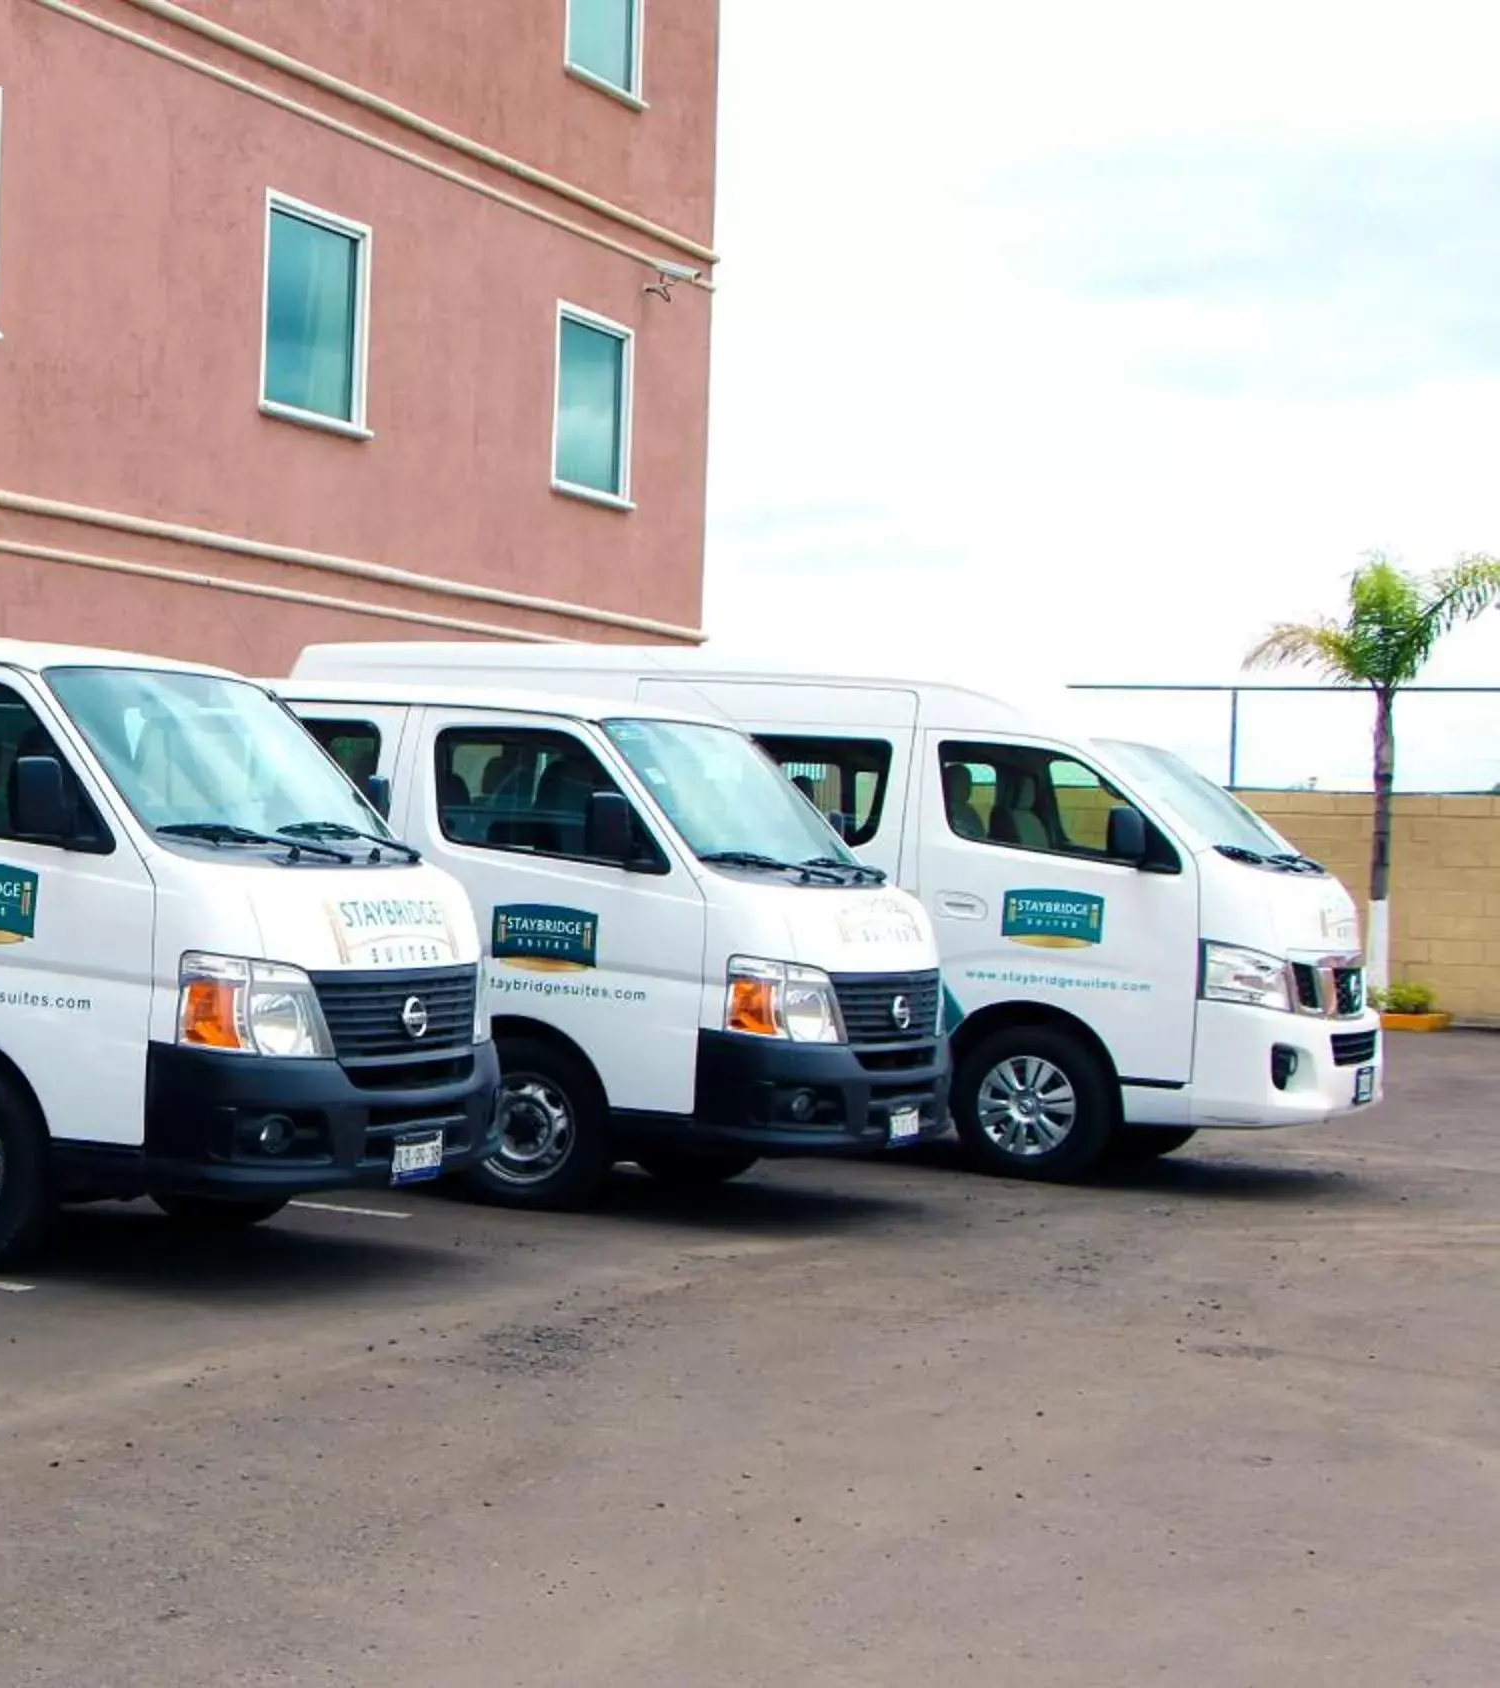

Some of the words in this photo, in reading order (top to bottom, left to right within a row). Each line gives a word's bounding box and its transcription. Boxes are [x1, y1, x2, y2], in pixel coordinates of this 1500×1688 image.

[339, 900, 443, 927] STAYBRIDGE
[1016, 899, 1088, 915] STAYBRIDGE
[507, 916, 582, 935] STAYBRIDGE
[371, 945, 439, 964] SUITES
[490, 976, 647, 1001] taybridgesuites.com
[965, 969, 1152, 992] www.staybridgesuites.com
